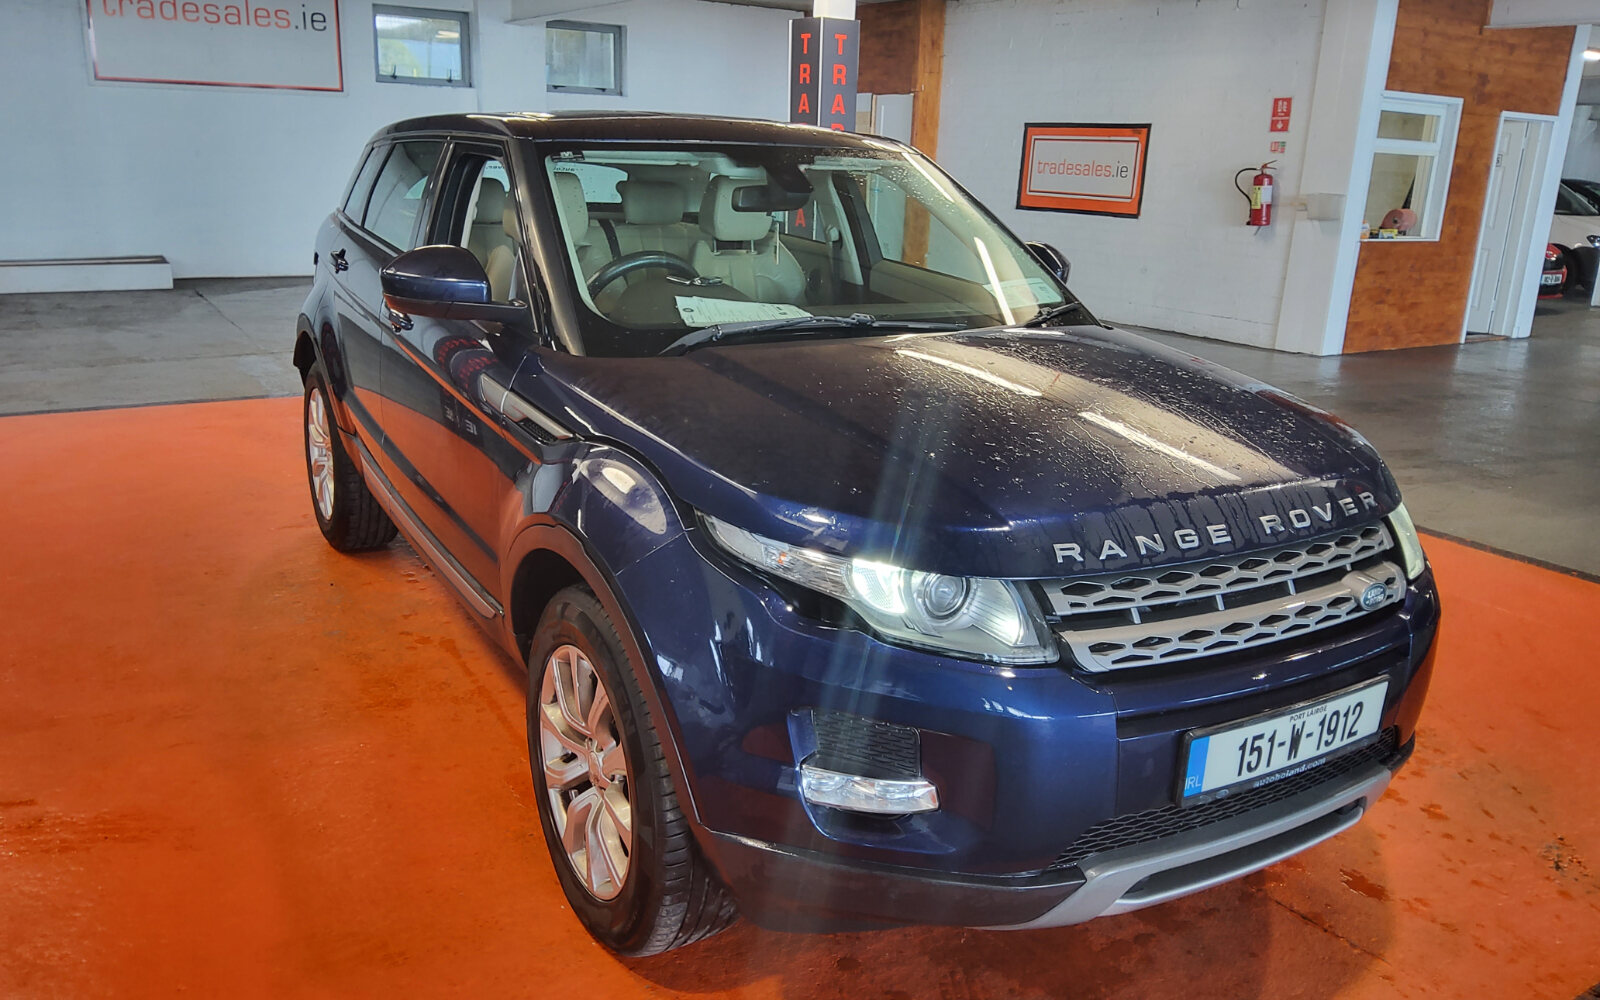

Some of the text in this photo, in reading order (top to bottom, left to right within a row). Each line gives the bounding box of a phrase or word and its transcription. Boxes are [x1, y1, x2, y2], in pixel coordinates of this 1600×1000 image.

[798, 33, 811, 125] TRA
[1037, 159, 1128, 178] tradesales.ie
[1053, 492, 1378, 564] RANGE ROVER
[1237, 701, 1364, 777] 151-W-1912
[1290, 712, 1305, 722] PORT
[1185, 775, 1201, 790] IRL
